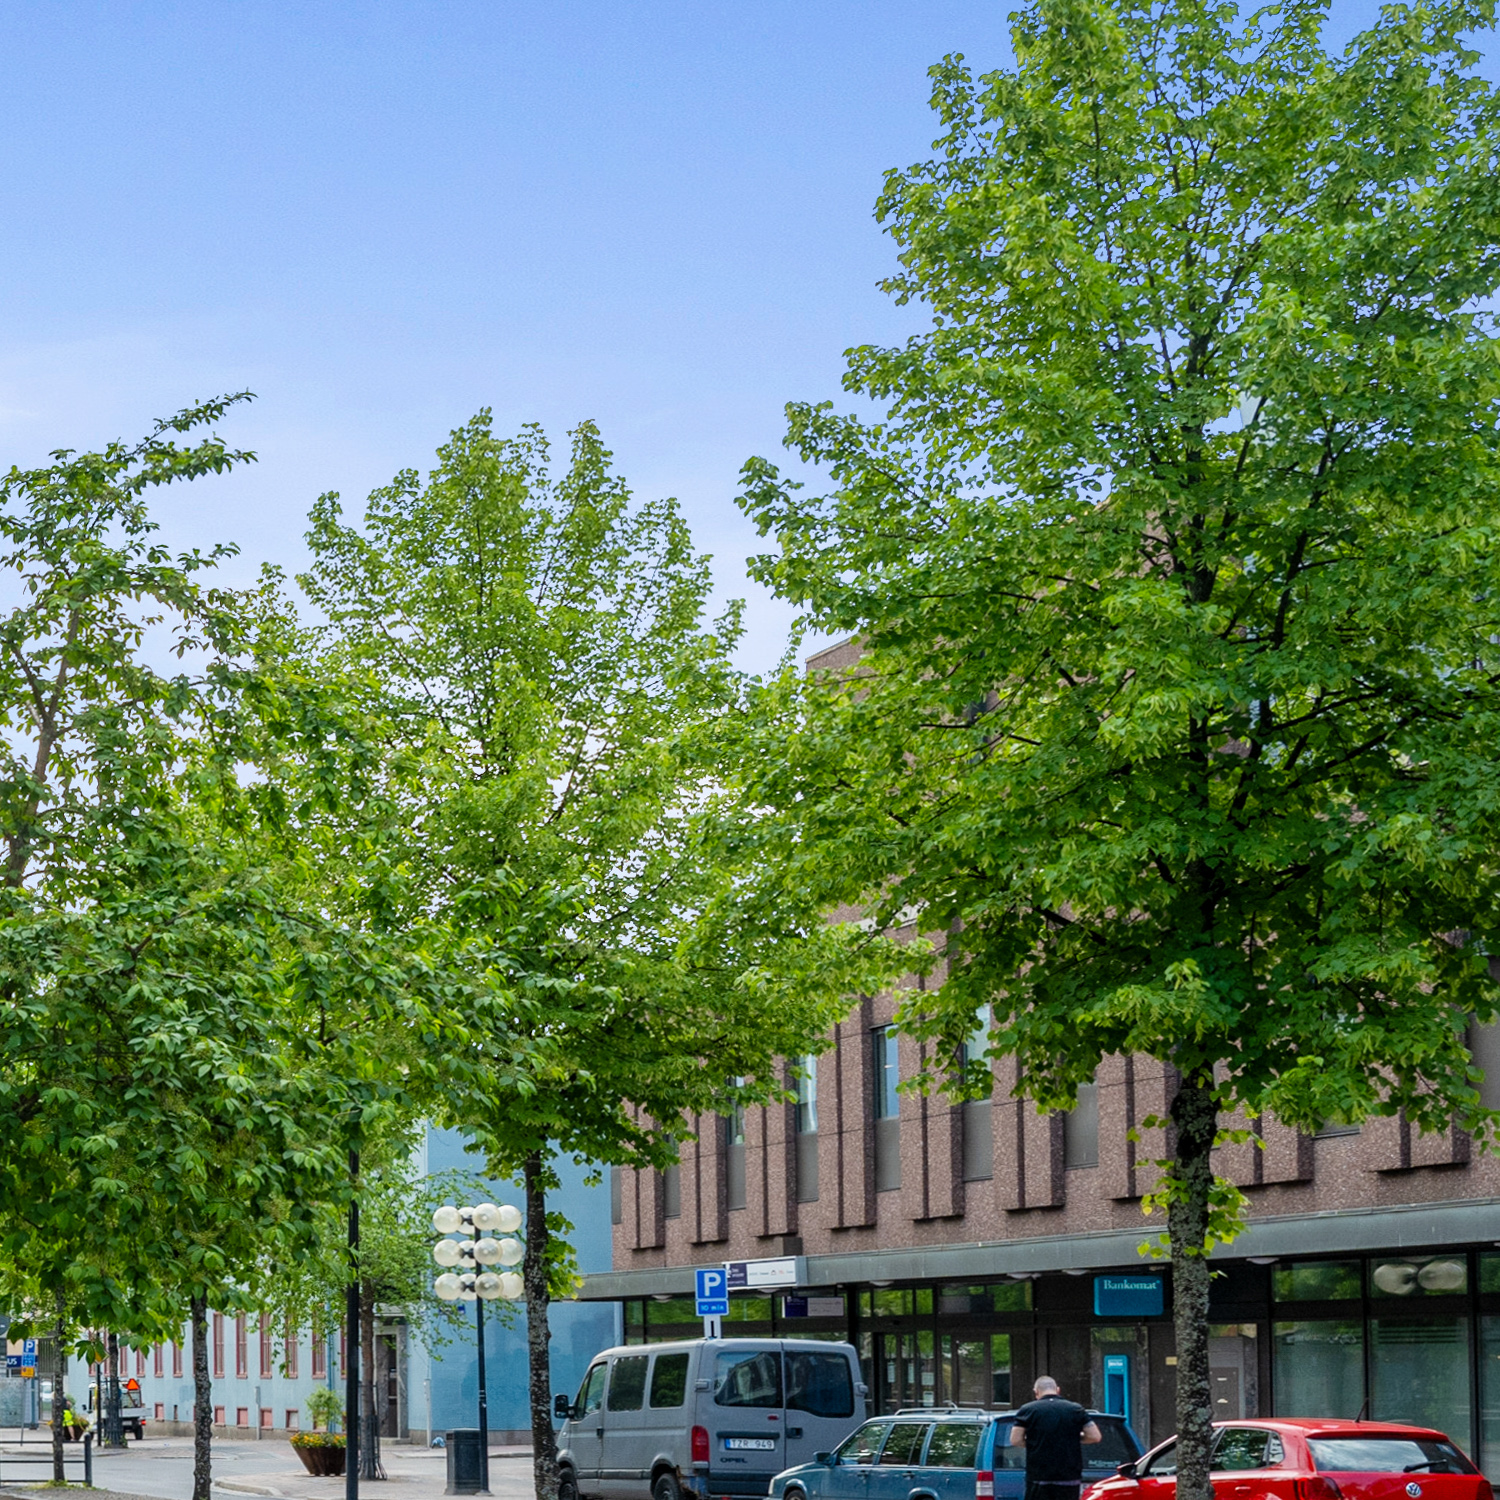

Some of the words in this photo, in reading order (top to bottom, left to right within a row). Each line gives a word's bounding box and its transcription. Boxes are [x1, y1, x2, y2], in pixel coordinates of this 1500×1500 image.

[703, 1272, 722, 1297] P
[1103, 1279, 1157, 1290] Bankomat
[711, 1303, 725, 1311] min
[754, 1440, 773, 1448] 949
